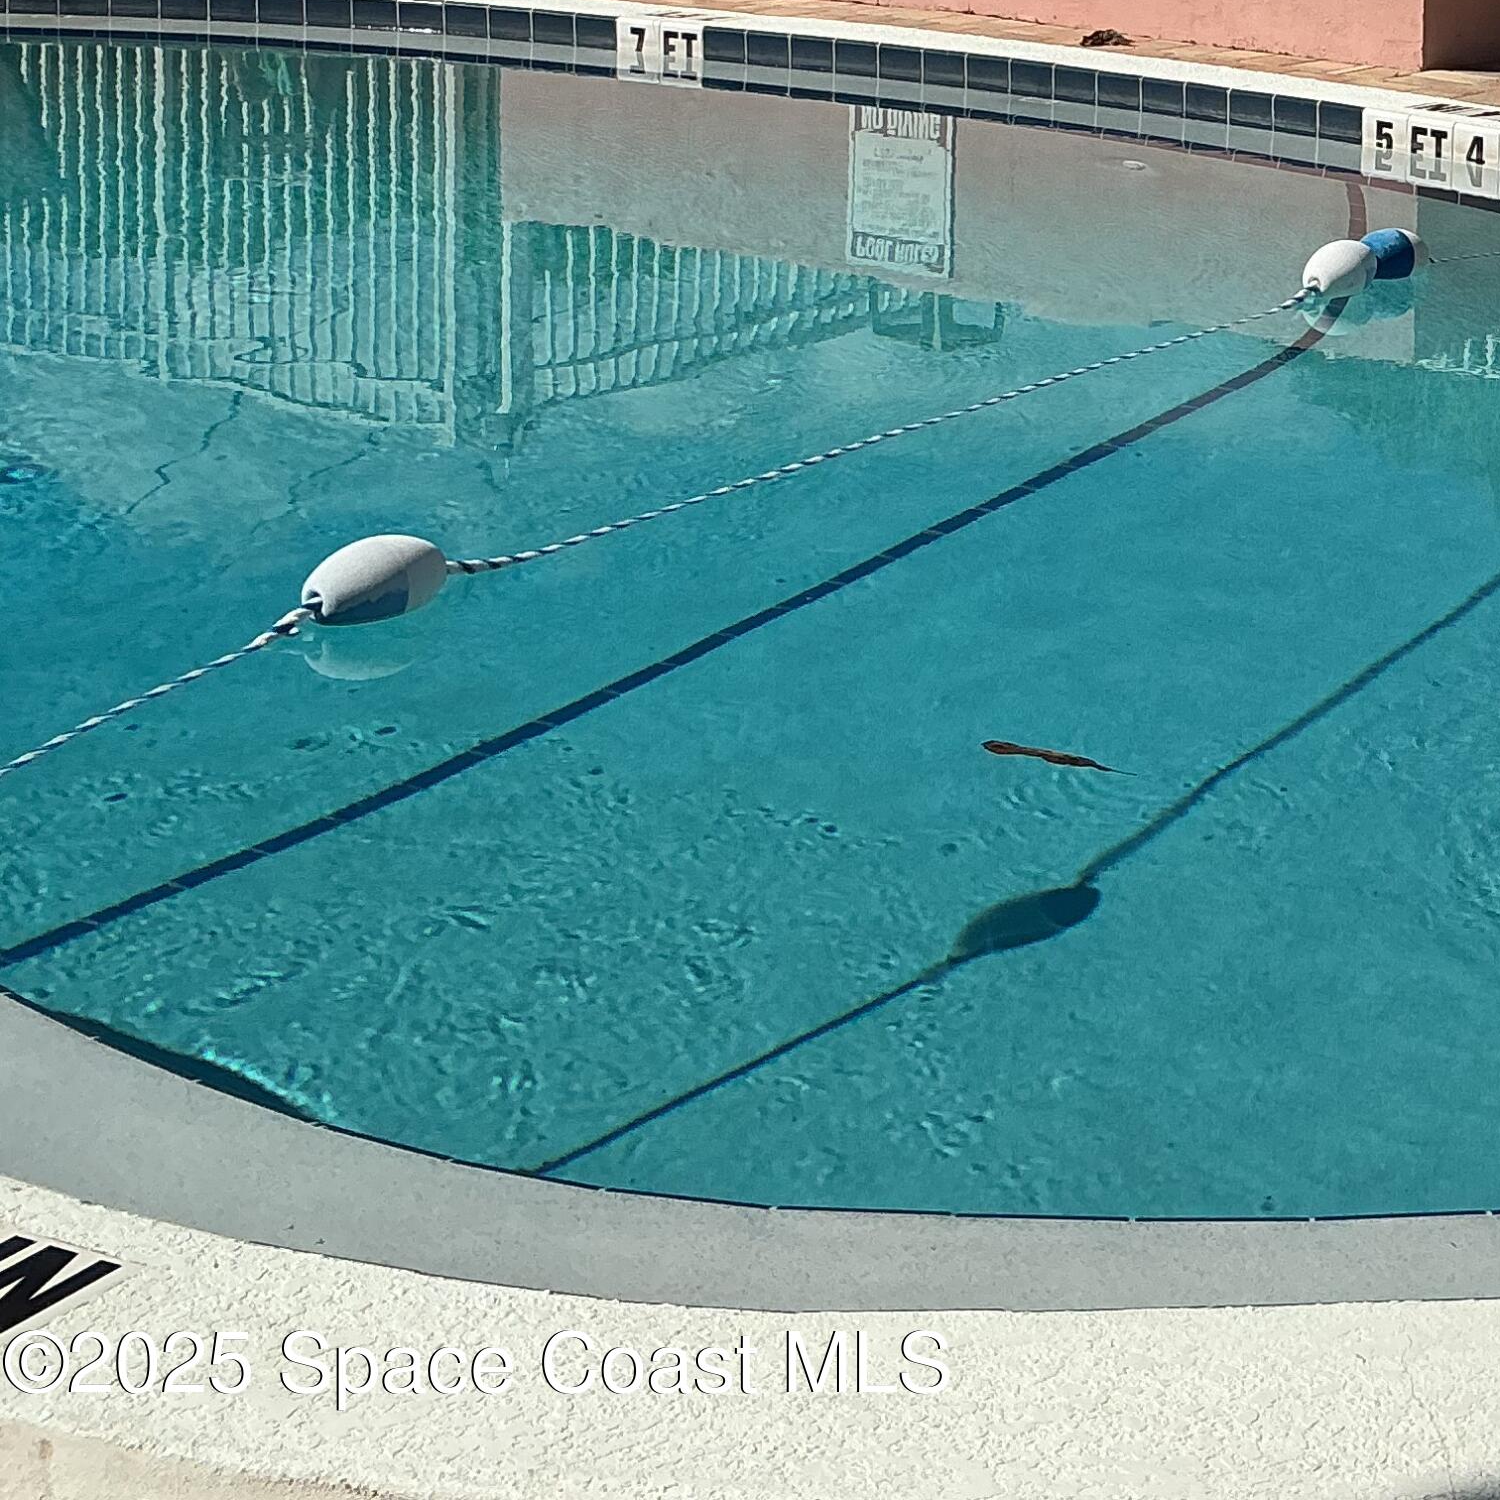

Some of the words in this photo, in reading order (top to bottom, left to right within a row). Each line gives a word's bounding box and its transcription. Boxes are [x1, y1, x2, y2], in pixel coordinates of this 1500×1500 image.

[630, 26, 646, 52] 7
[663, 31, 697, 58] FT
[1376, 120, 1394, 150] 5
[1411, 126, 1448, 158] FT
[1466, 135, 1486, 165] 4
